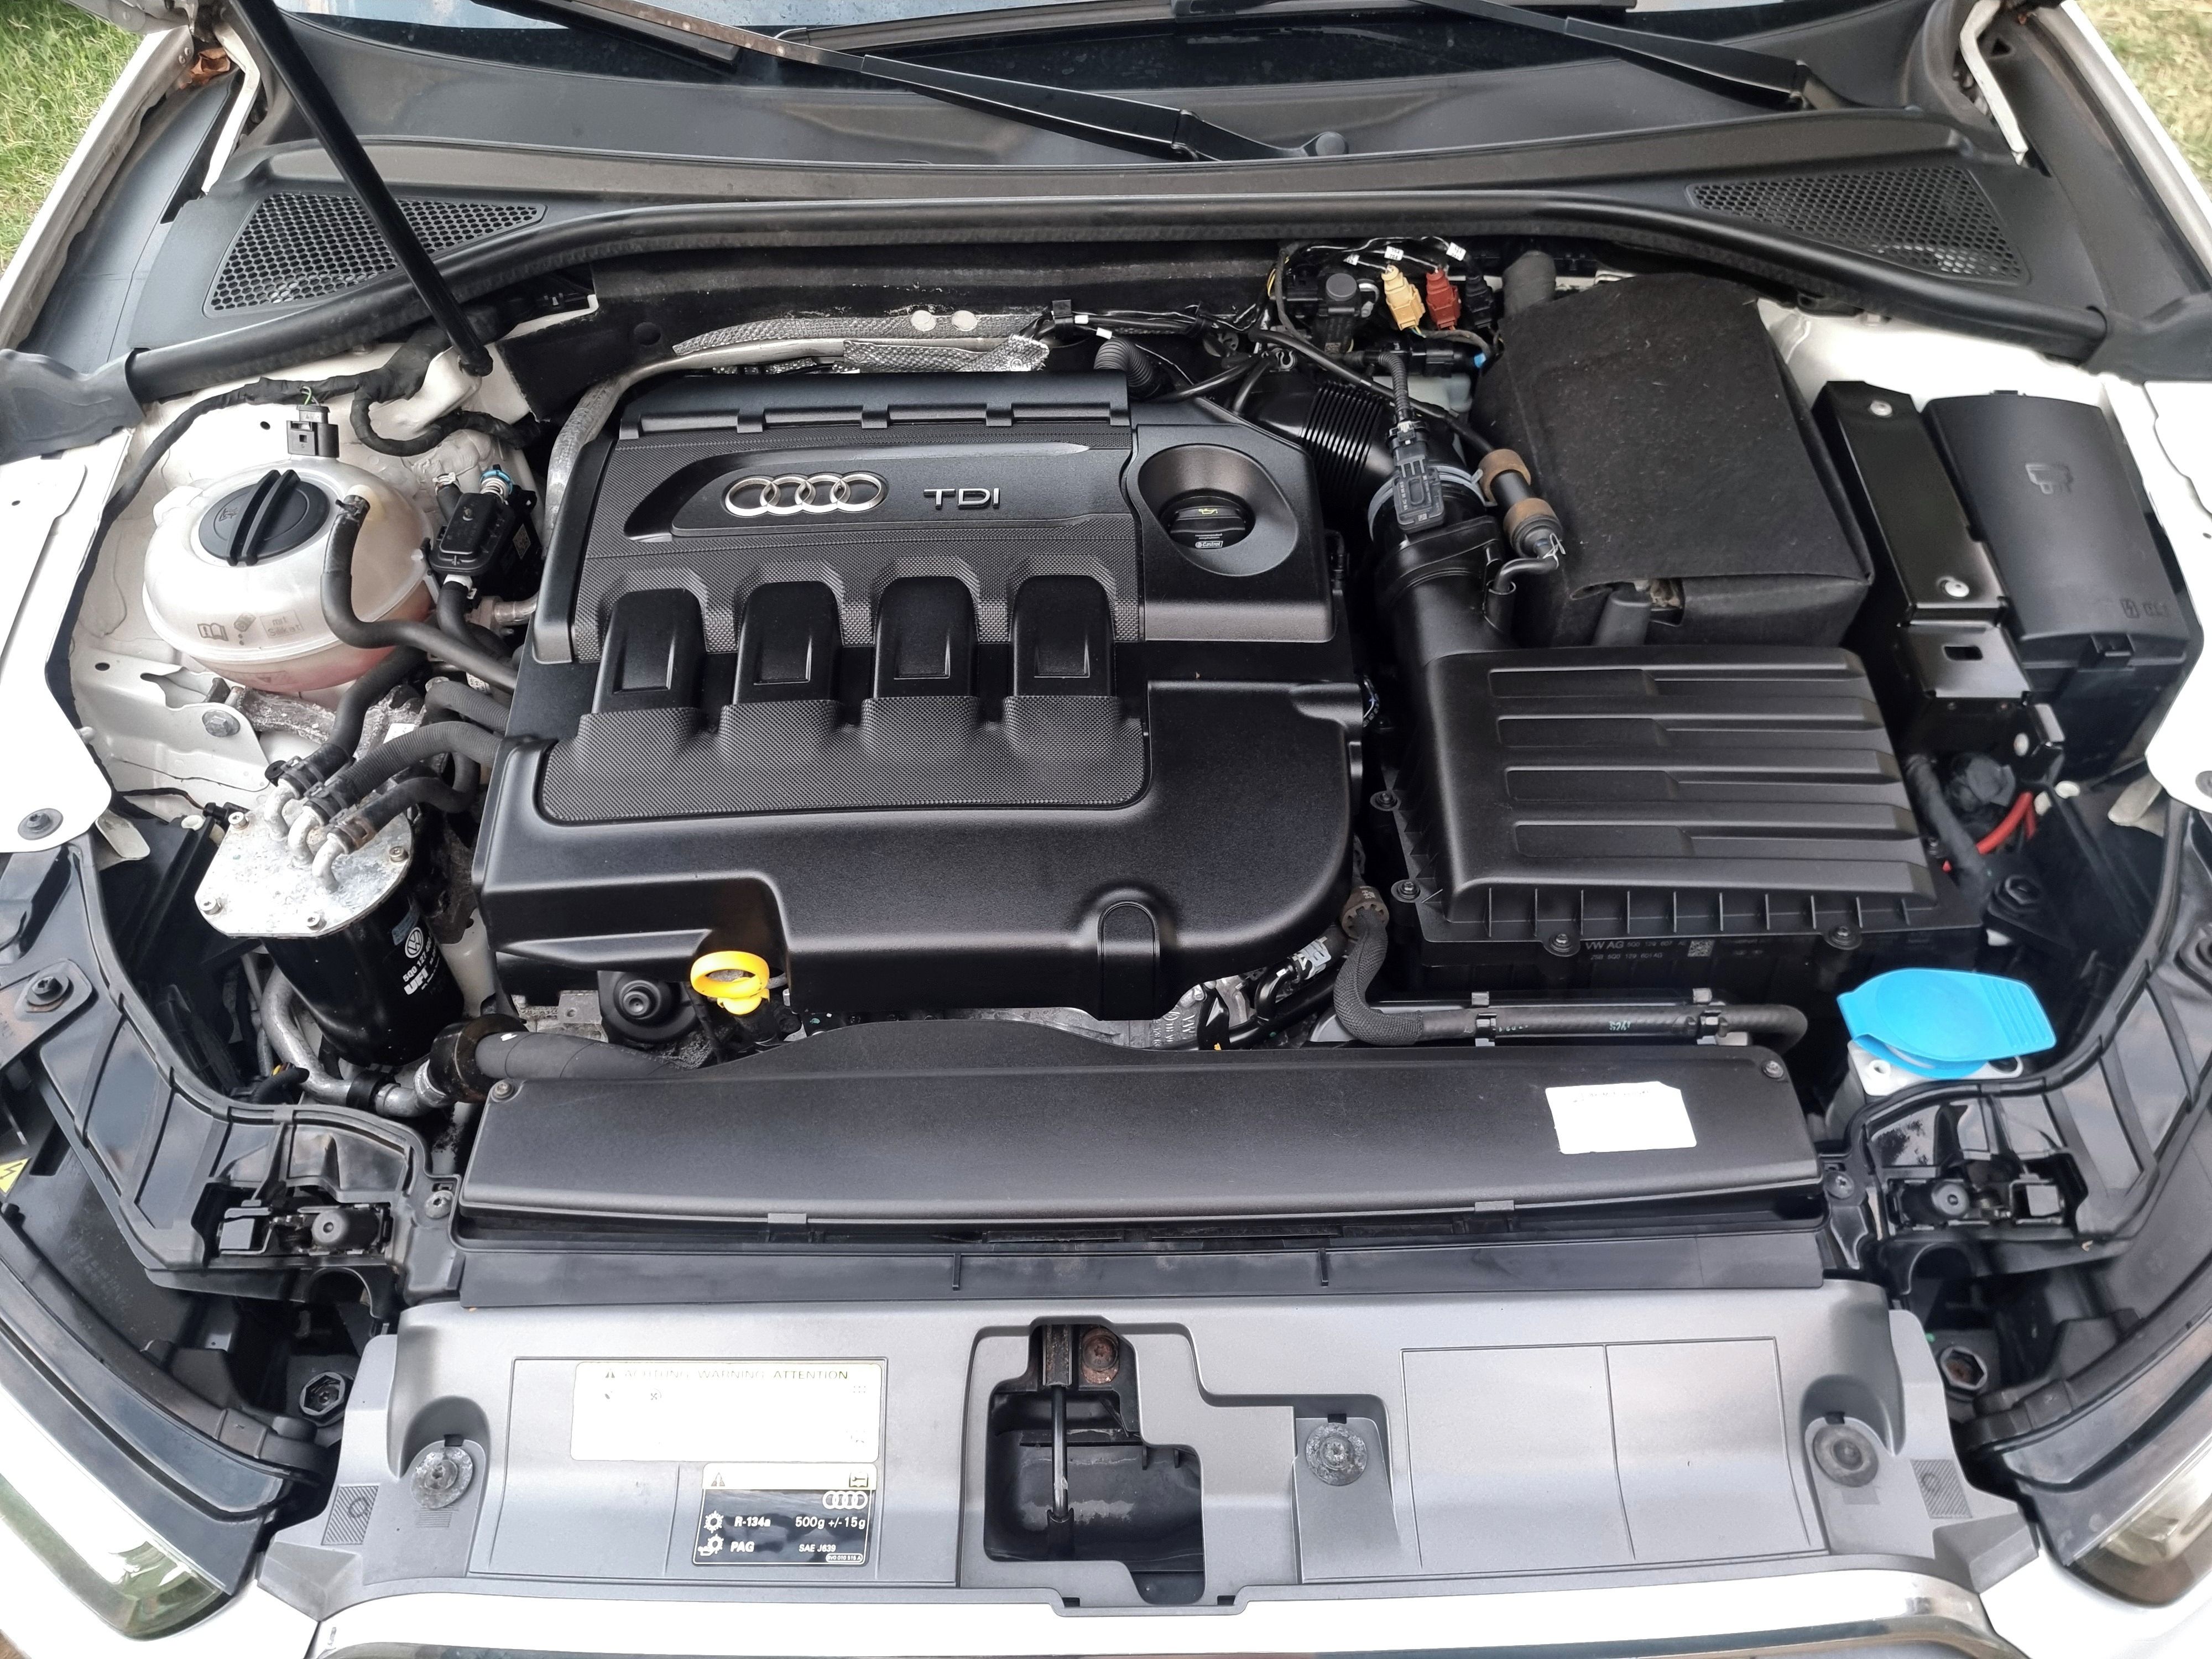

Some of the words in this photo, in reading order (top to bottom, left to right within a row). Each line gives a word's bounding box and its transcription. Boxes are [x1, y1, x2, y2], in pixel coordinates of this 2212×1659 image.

[924, 488, 1000, 509] TDI
[1585, 941, 1605, 950] VW
[1606, 941, 1624, 950] AG
[697, 1370, 764, 1379] WARNING
[774, 1370, 848, 1380] ATTENTION
[734, 1516, 771, 1527] R-134a
[795, 1516, 825, 1530] 500g
[730, 1541, 755, 1552] PAG
[799, 1544, 815, 1552] SAE
[817, 1544, 836, 1552] J639
